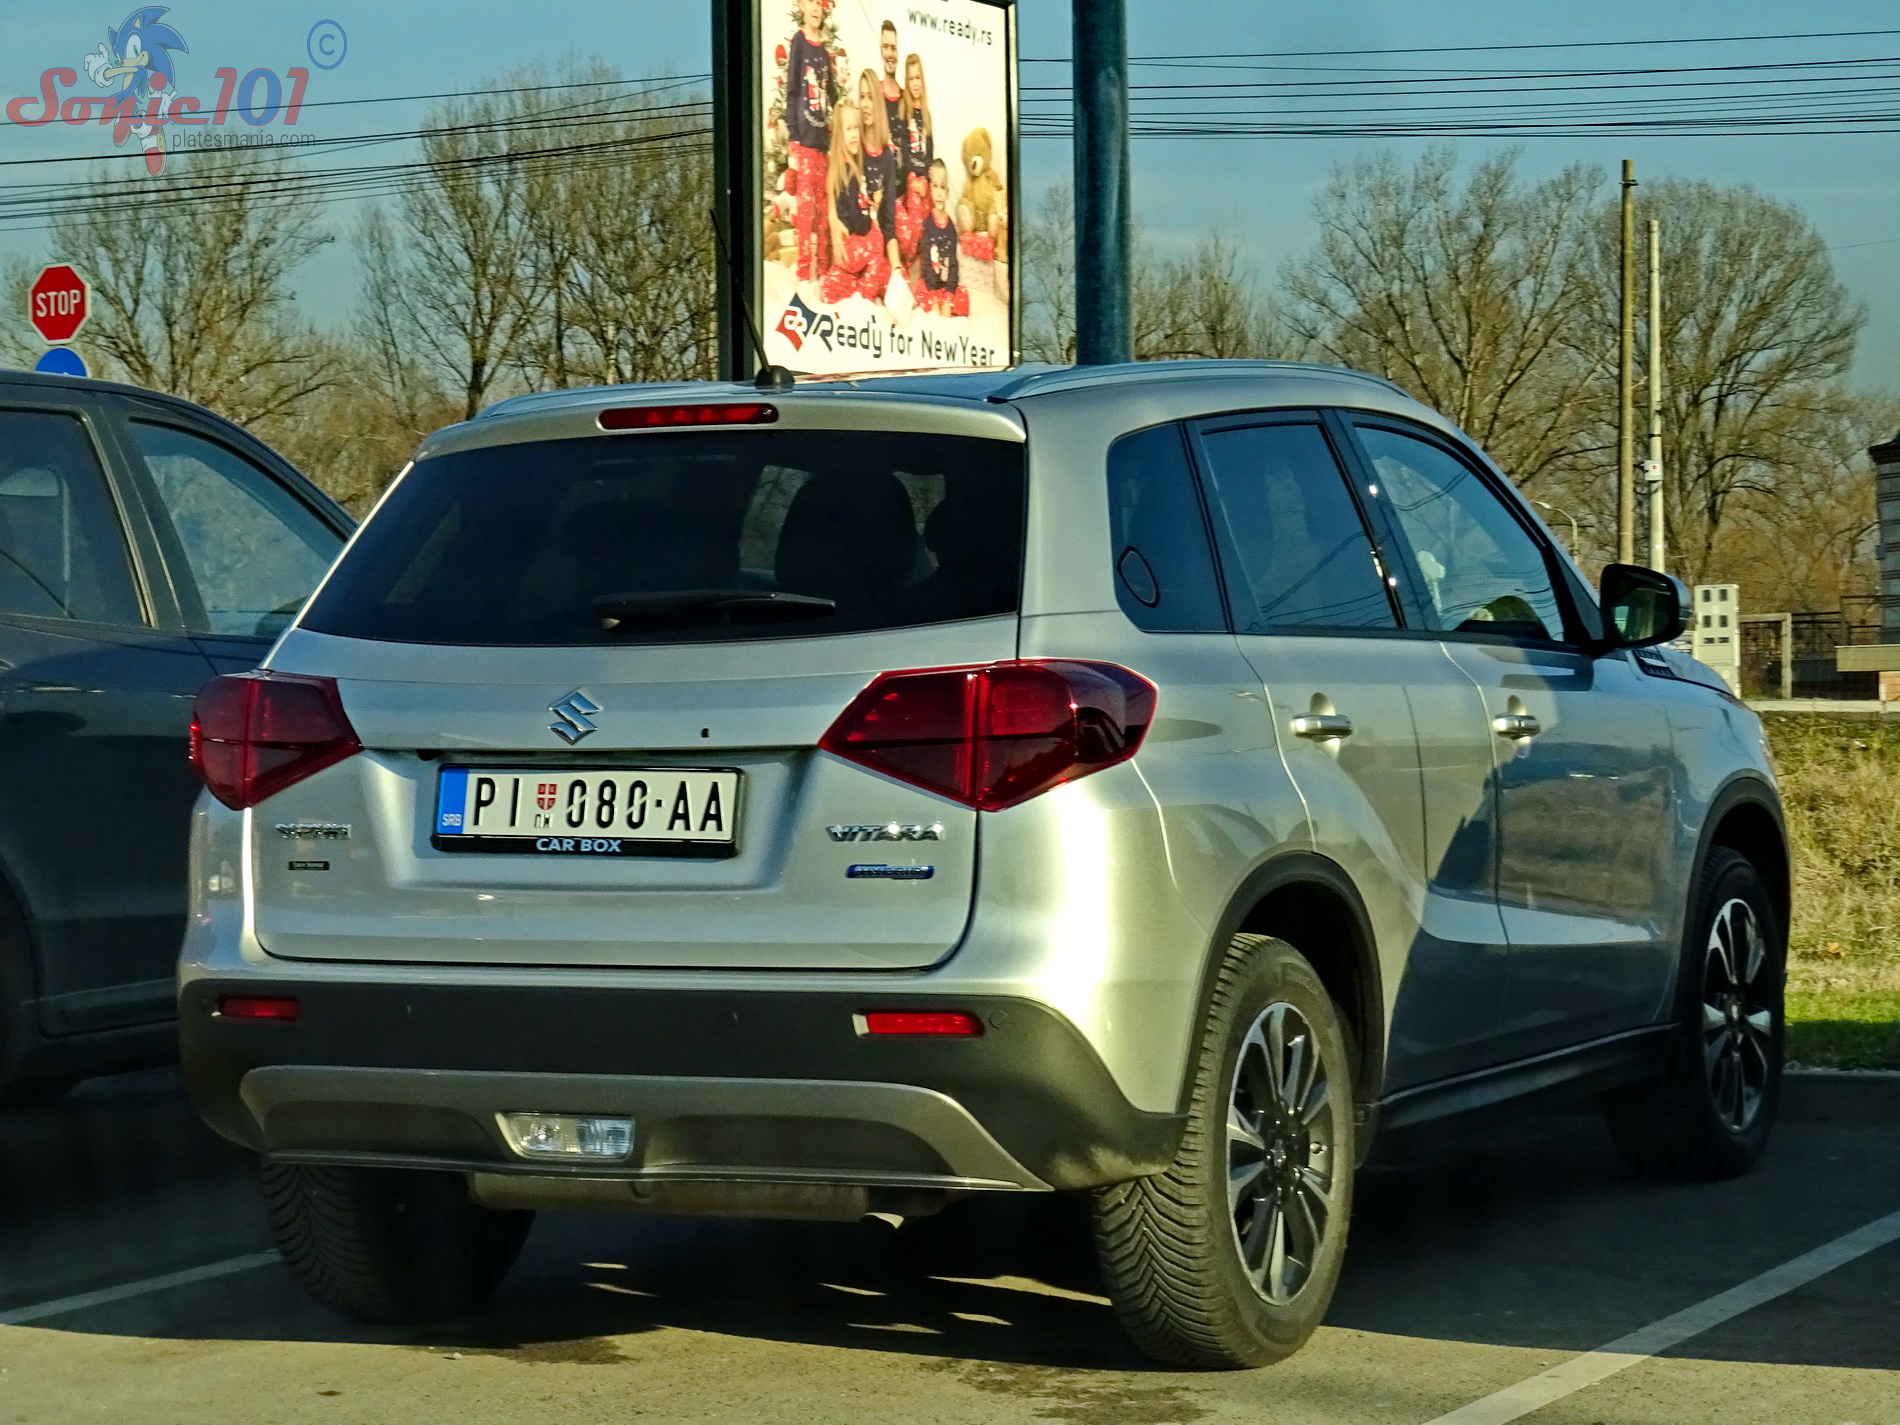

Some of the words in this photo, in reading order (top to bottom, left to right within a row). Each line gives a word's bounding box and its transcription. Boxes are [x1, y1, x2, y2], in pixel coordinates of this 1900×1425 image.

[906, 8, 993, 46] www.ready.rs
[36, 289, 81, 317] STOP
[812, 312, 882, 359] Ready
[889, 323, 914, 354] for
[473, 777, 521, 827] PI
[441, 813, 462, 827] SRB
[825, 824, 942, 842] VITARA
[536, 838, 575, 852] CAR
[580, 839, 622, 853] BOX
